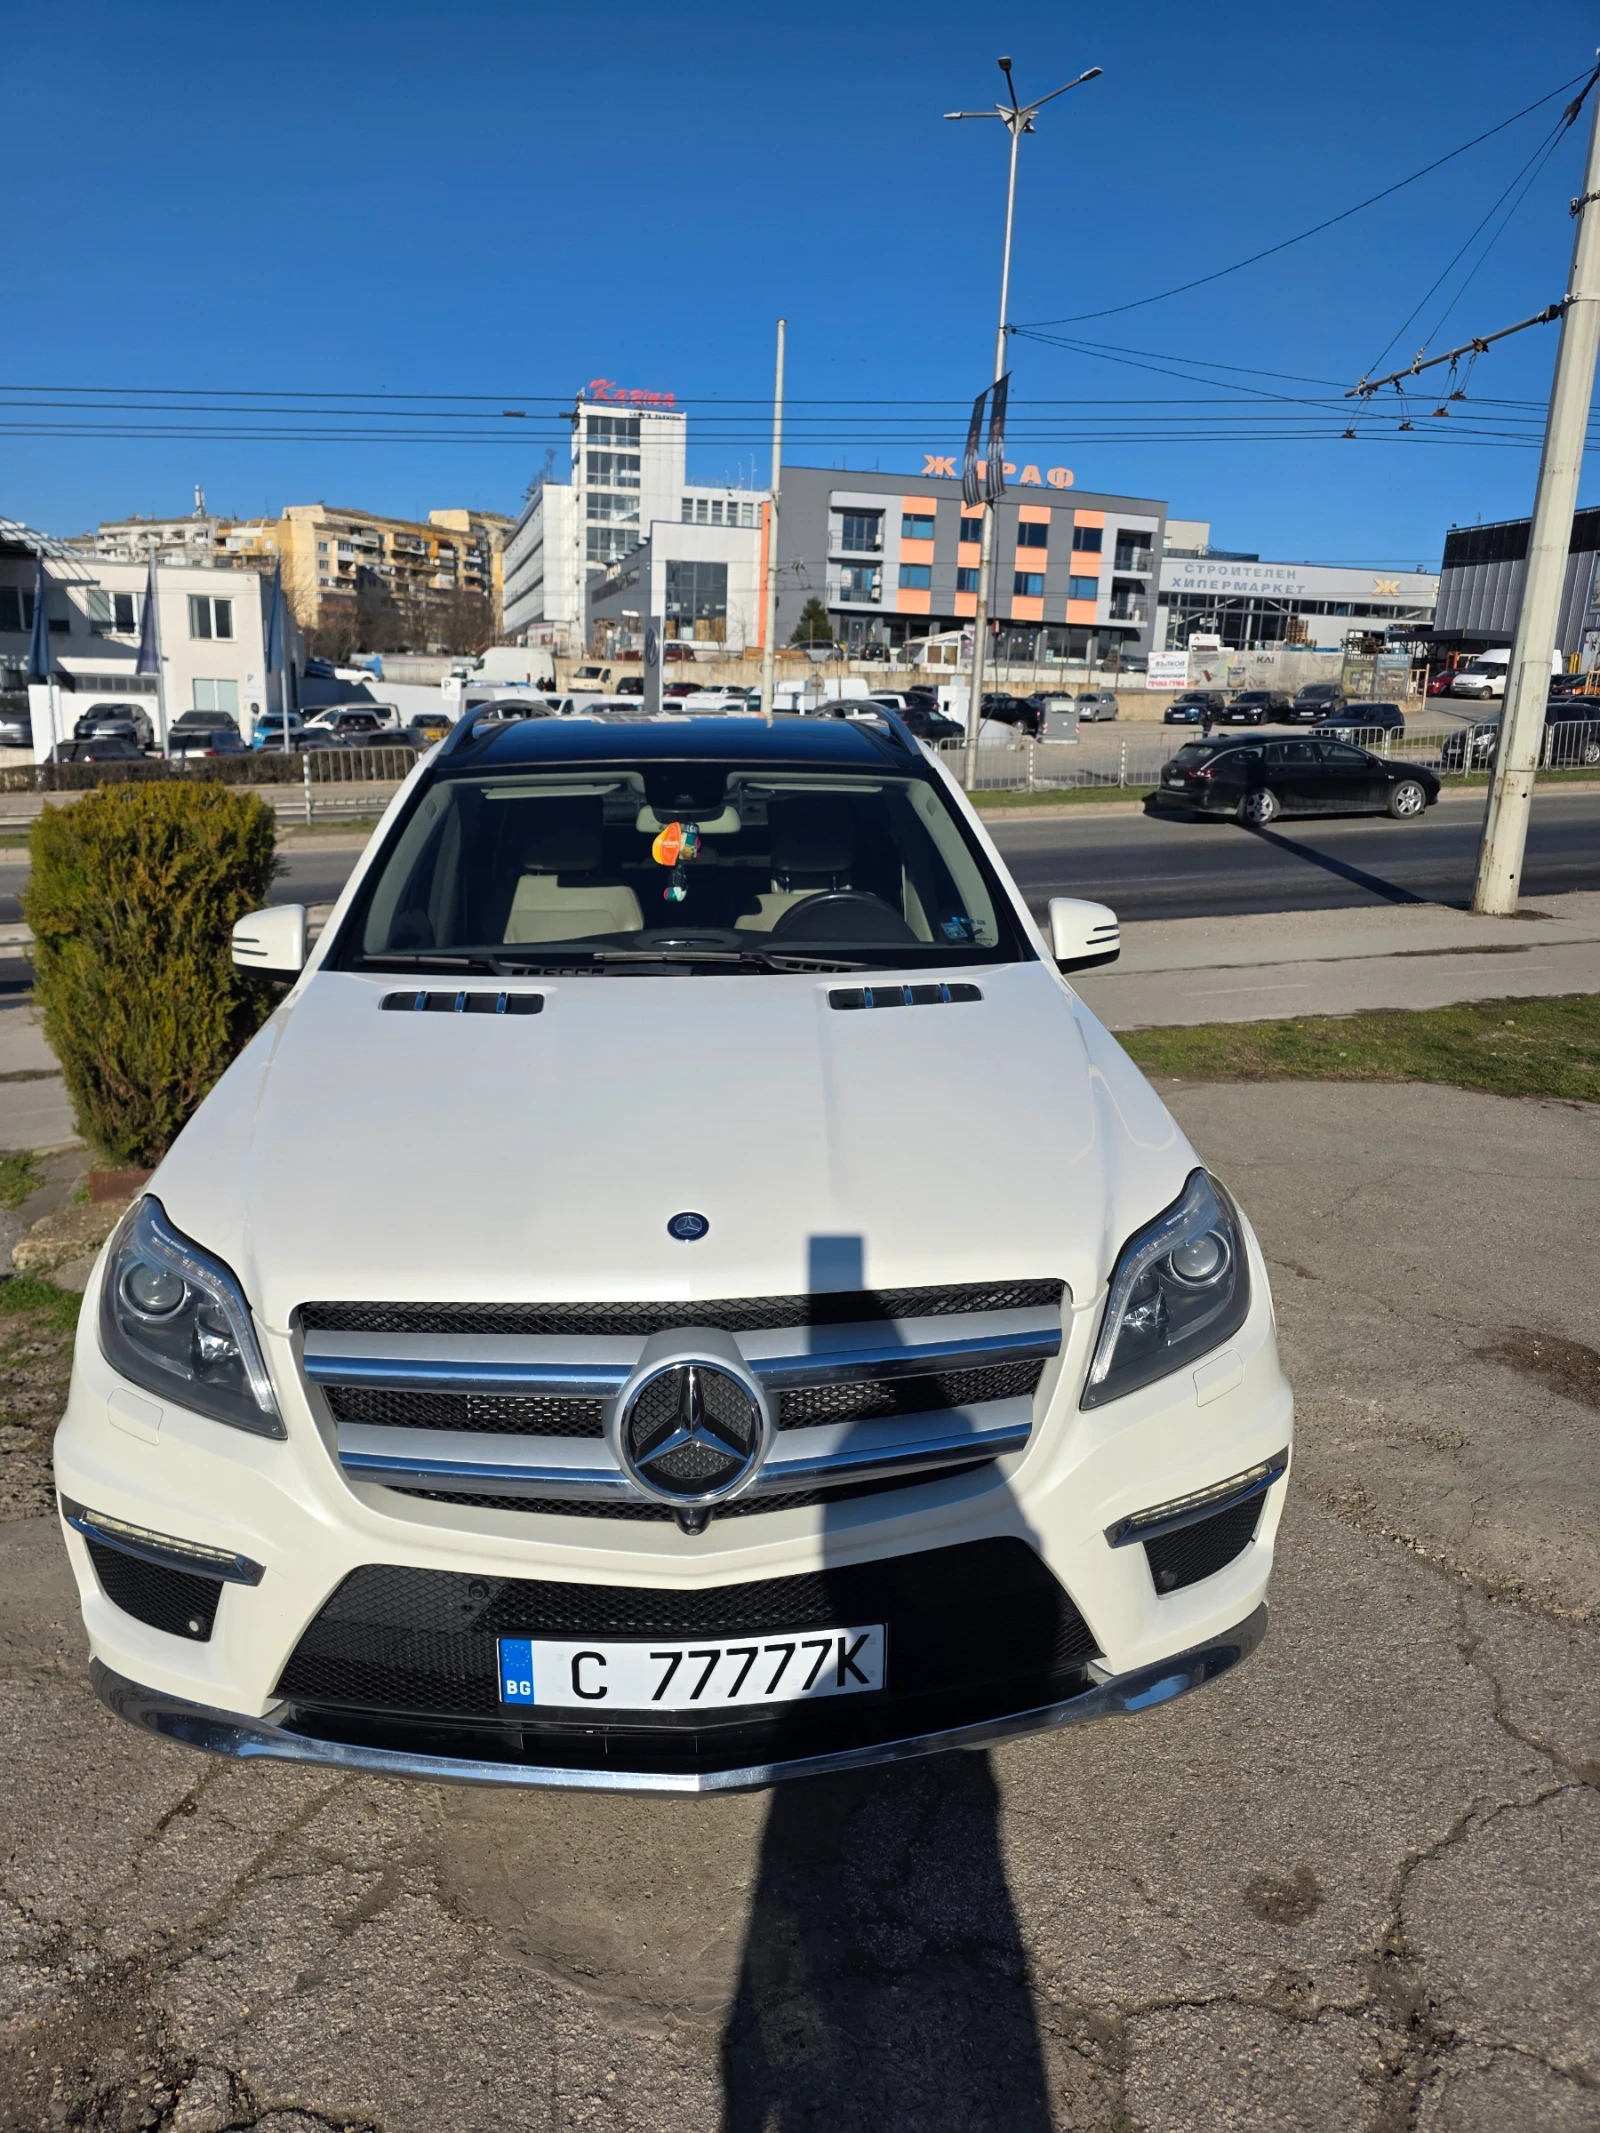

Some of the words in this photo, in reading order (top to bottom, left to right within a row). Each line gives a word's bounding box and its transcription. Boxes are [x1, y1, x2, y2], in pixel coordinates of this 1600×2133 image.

[1184, 564, 1296, 580] СТРОИТЕЛЕН
[1172, 577, 1305, 595] ХИПЕРМАРКЕТ
[570, 1651, 608, 1700] C
[649, 1633, 871, 1701] 77777K
[507, 1679, 531, 1696] BG
